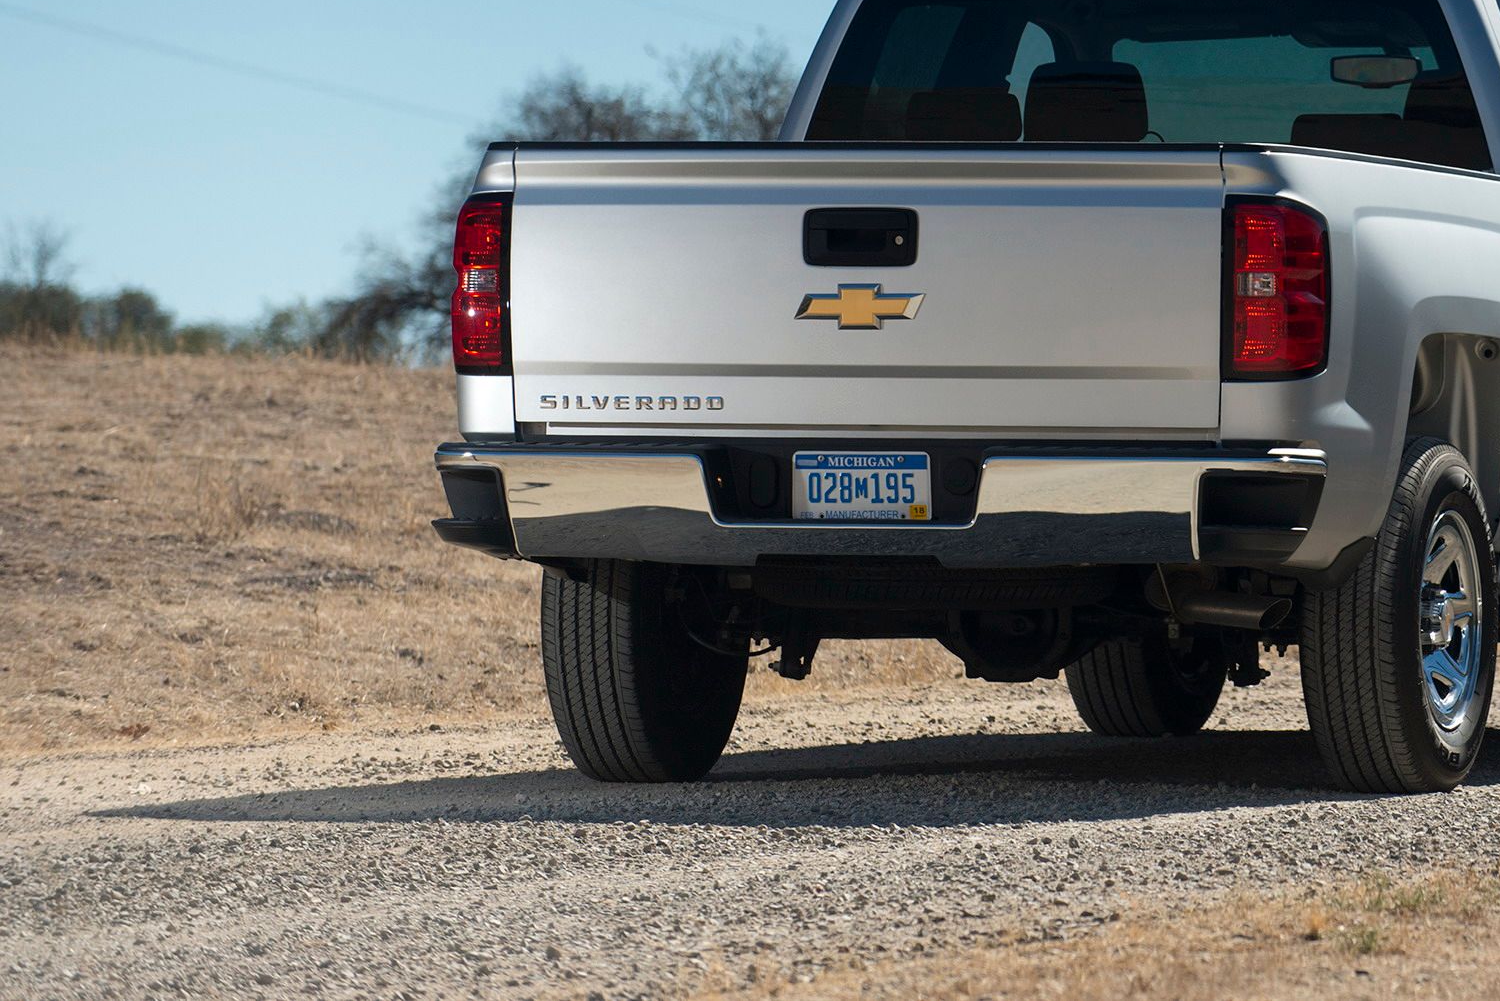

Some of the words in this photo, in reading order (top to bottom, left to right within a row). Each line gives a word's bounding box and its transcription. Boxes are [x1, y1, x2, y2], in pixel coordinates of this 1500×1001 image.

[540, 395, 724, 411] SILVERADO
[828, 456, 895, 467] MICHIGAN
[808, 472, 915, 504] 028M195
[825, 510, 899, 519] MANUFACTURER
